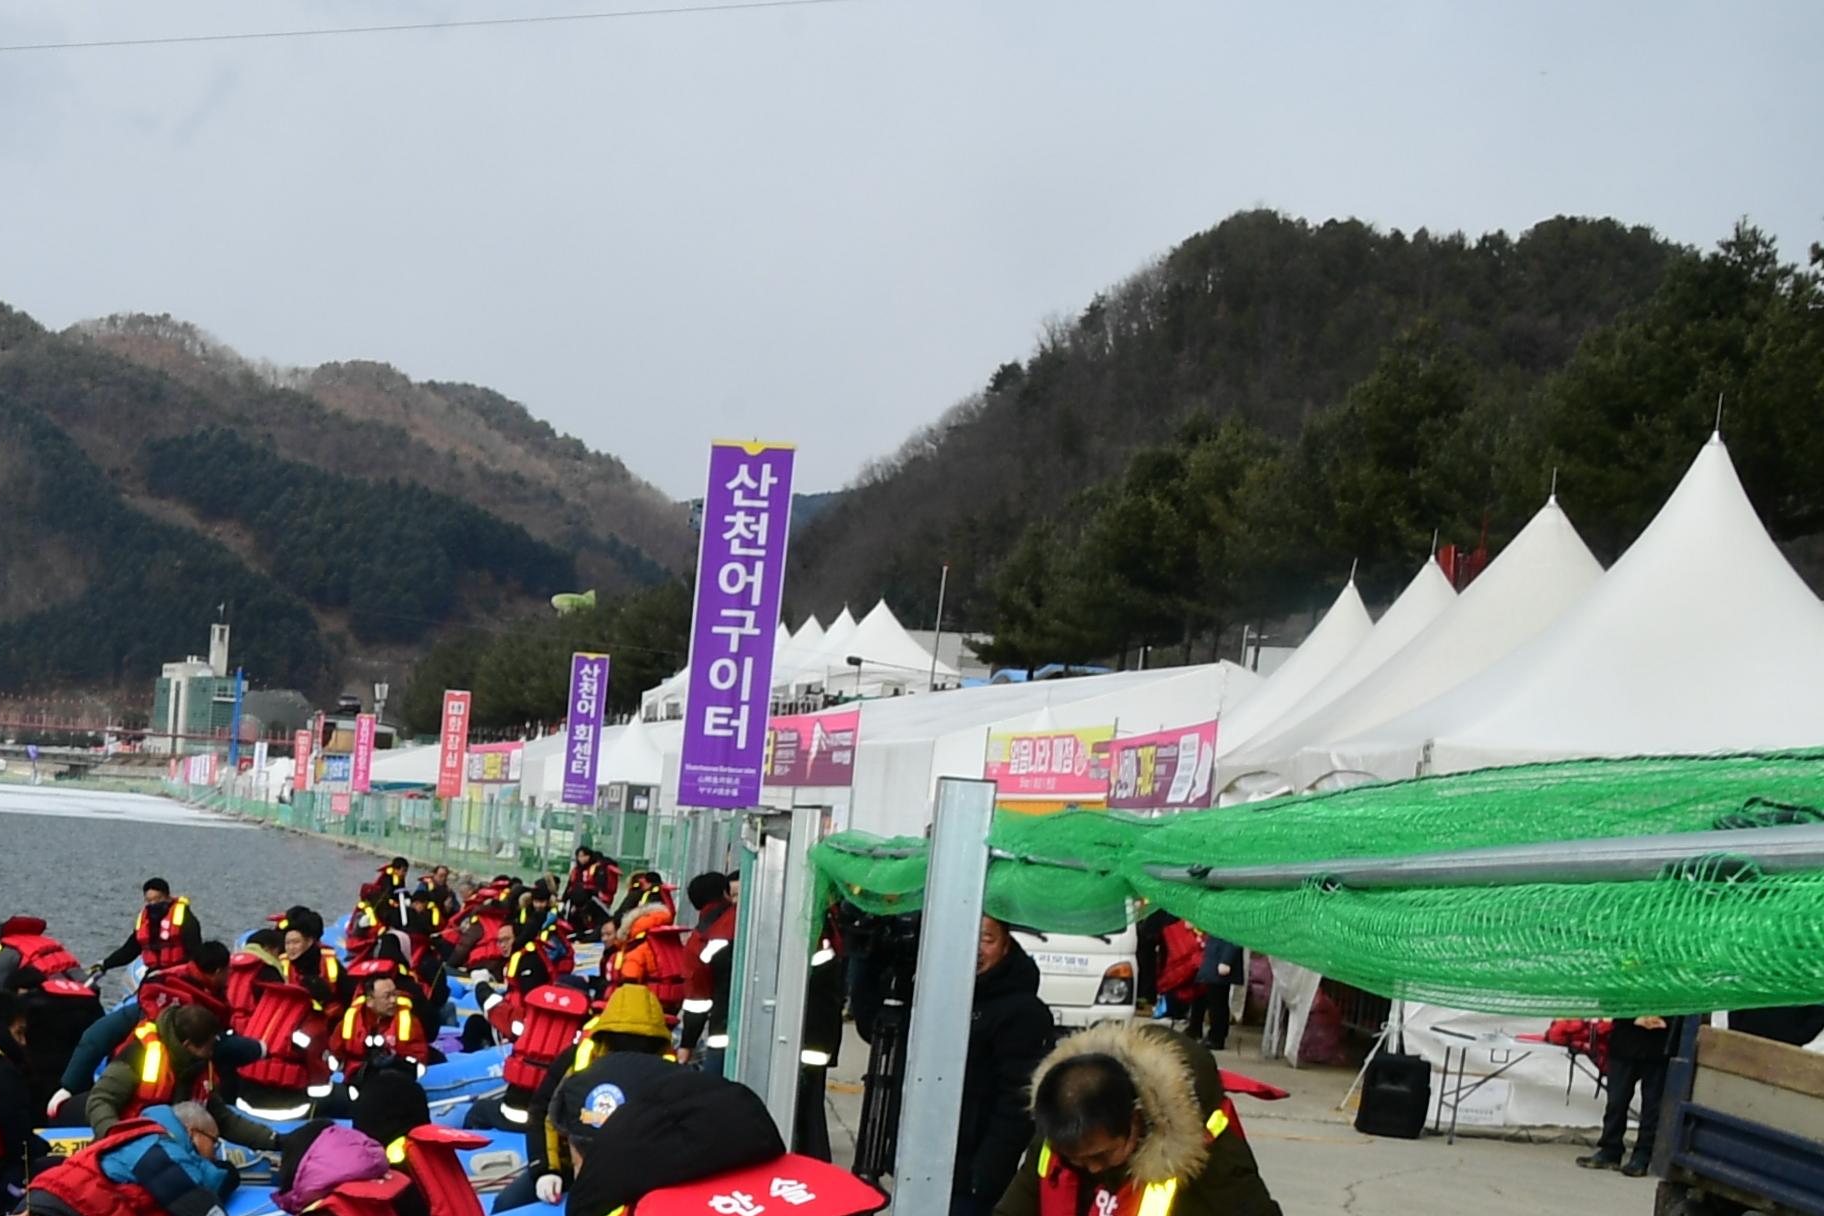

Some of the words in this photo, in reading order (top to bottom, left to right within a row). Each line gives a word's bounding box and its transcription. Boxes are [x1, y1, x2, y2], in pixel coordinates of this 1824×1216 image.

[703, 463, 778, 750] 산천어구이터
[576, 664, 601, 718] 산천어
[570, 724, 594, 779] 회센터
